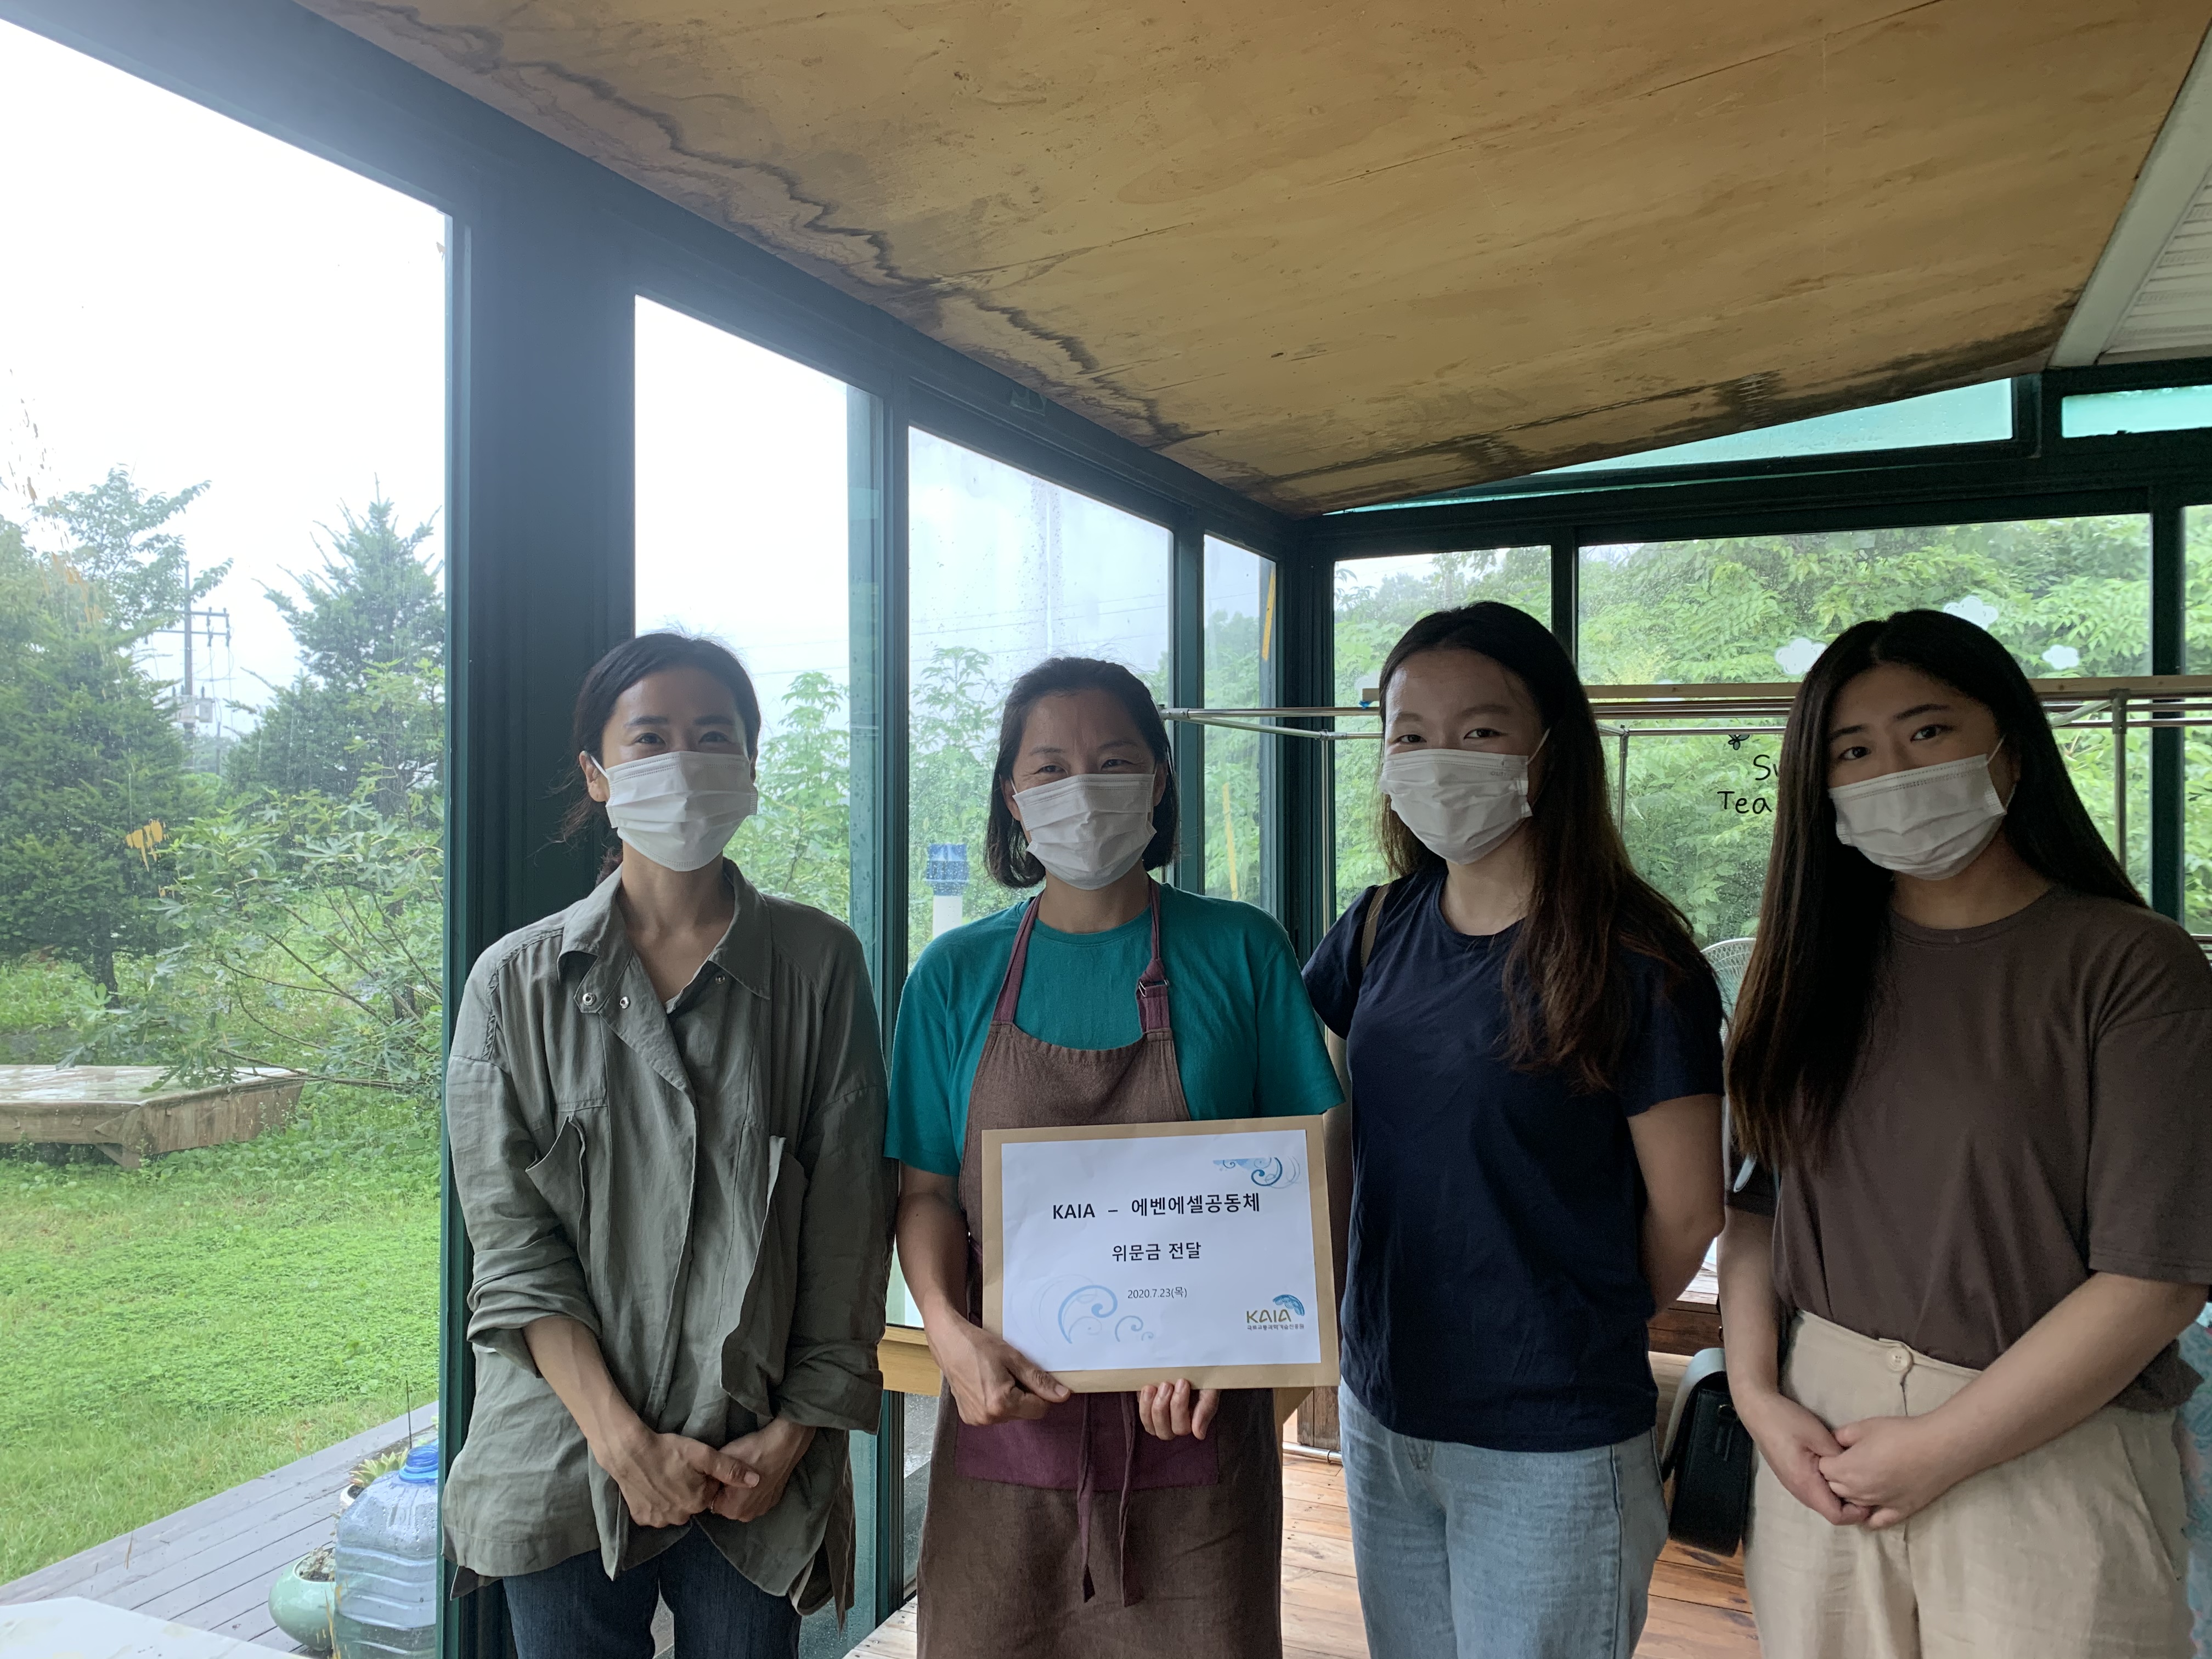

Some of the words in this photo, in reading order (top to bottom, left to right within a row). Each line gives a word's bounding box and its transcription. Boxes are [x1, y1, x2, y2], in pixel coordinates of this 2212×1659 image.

[1753, 754, 1779, 781] S
[1052, 1203, 1096, 1220] KAIA
[1131, 1192, 1260, 1217] 에벤에셀공동체
[1111, 1243, 1161, 1262] 위문금
[1169, 1242, 1202, 1260] 전달
[1127, 1286, 1188, 1299] 2020.7.23(목)
[1246, 1309, 1292, 1324] KAIA
